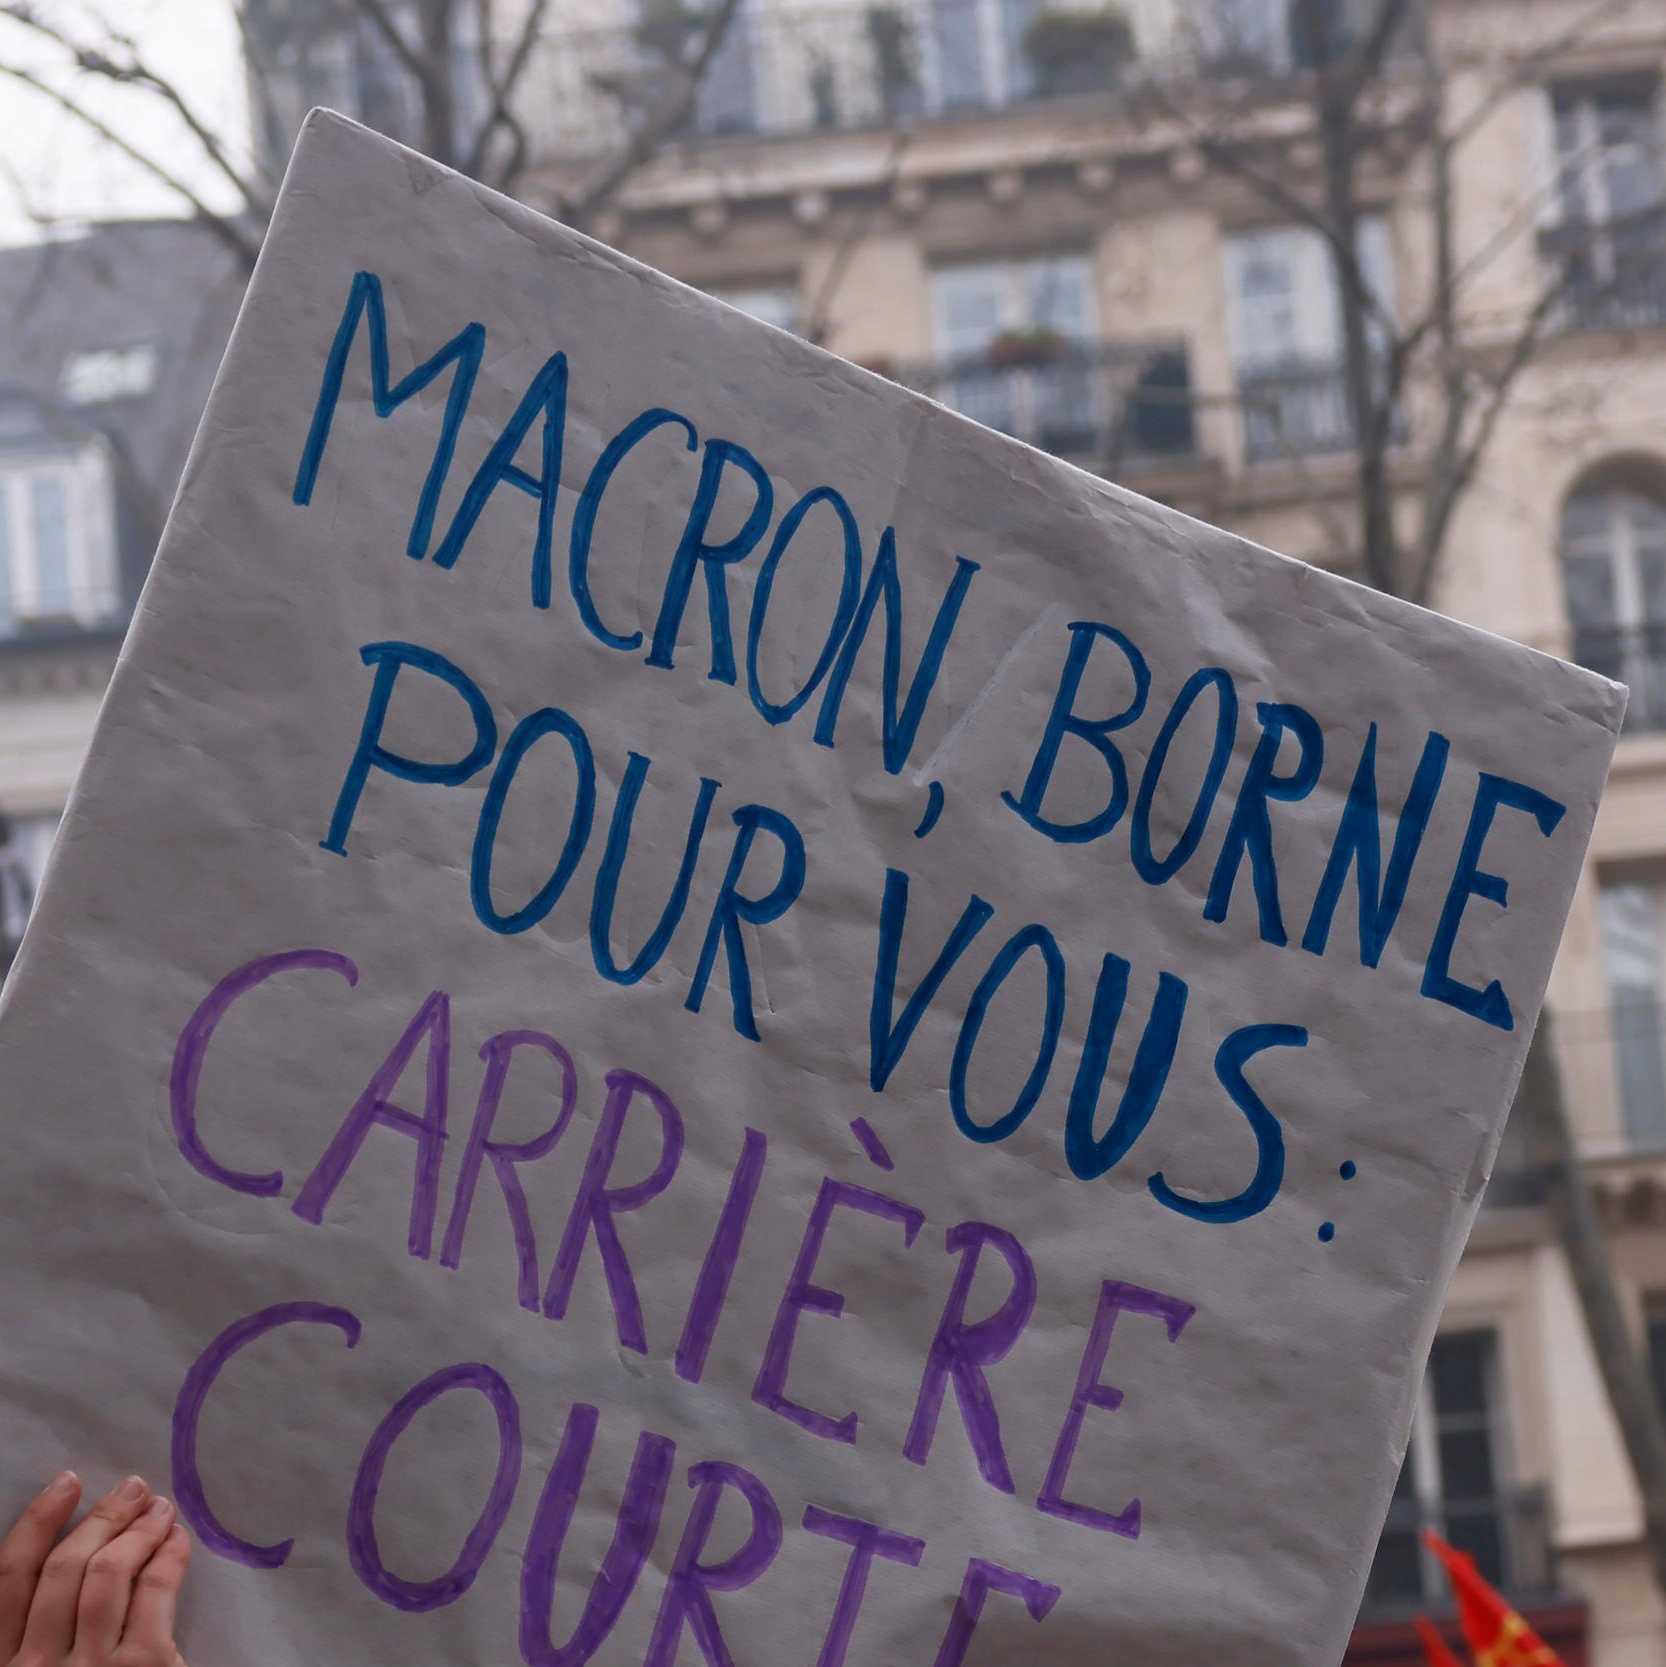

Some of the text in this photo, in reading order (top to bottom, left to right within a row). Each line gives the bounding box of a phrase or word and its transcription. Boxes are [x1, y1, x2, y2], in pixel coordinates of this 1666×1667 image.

[294, 272, 1565, 1030] MACRON, BORNE
[320, 642, 1356, 1242] POUR VOUS:
[170, 950, 1196, 1539] CARRIÈRE
